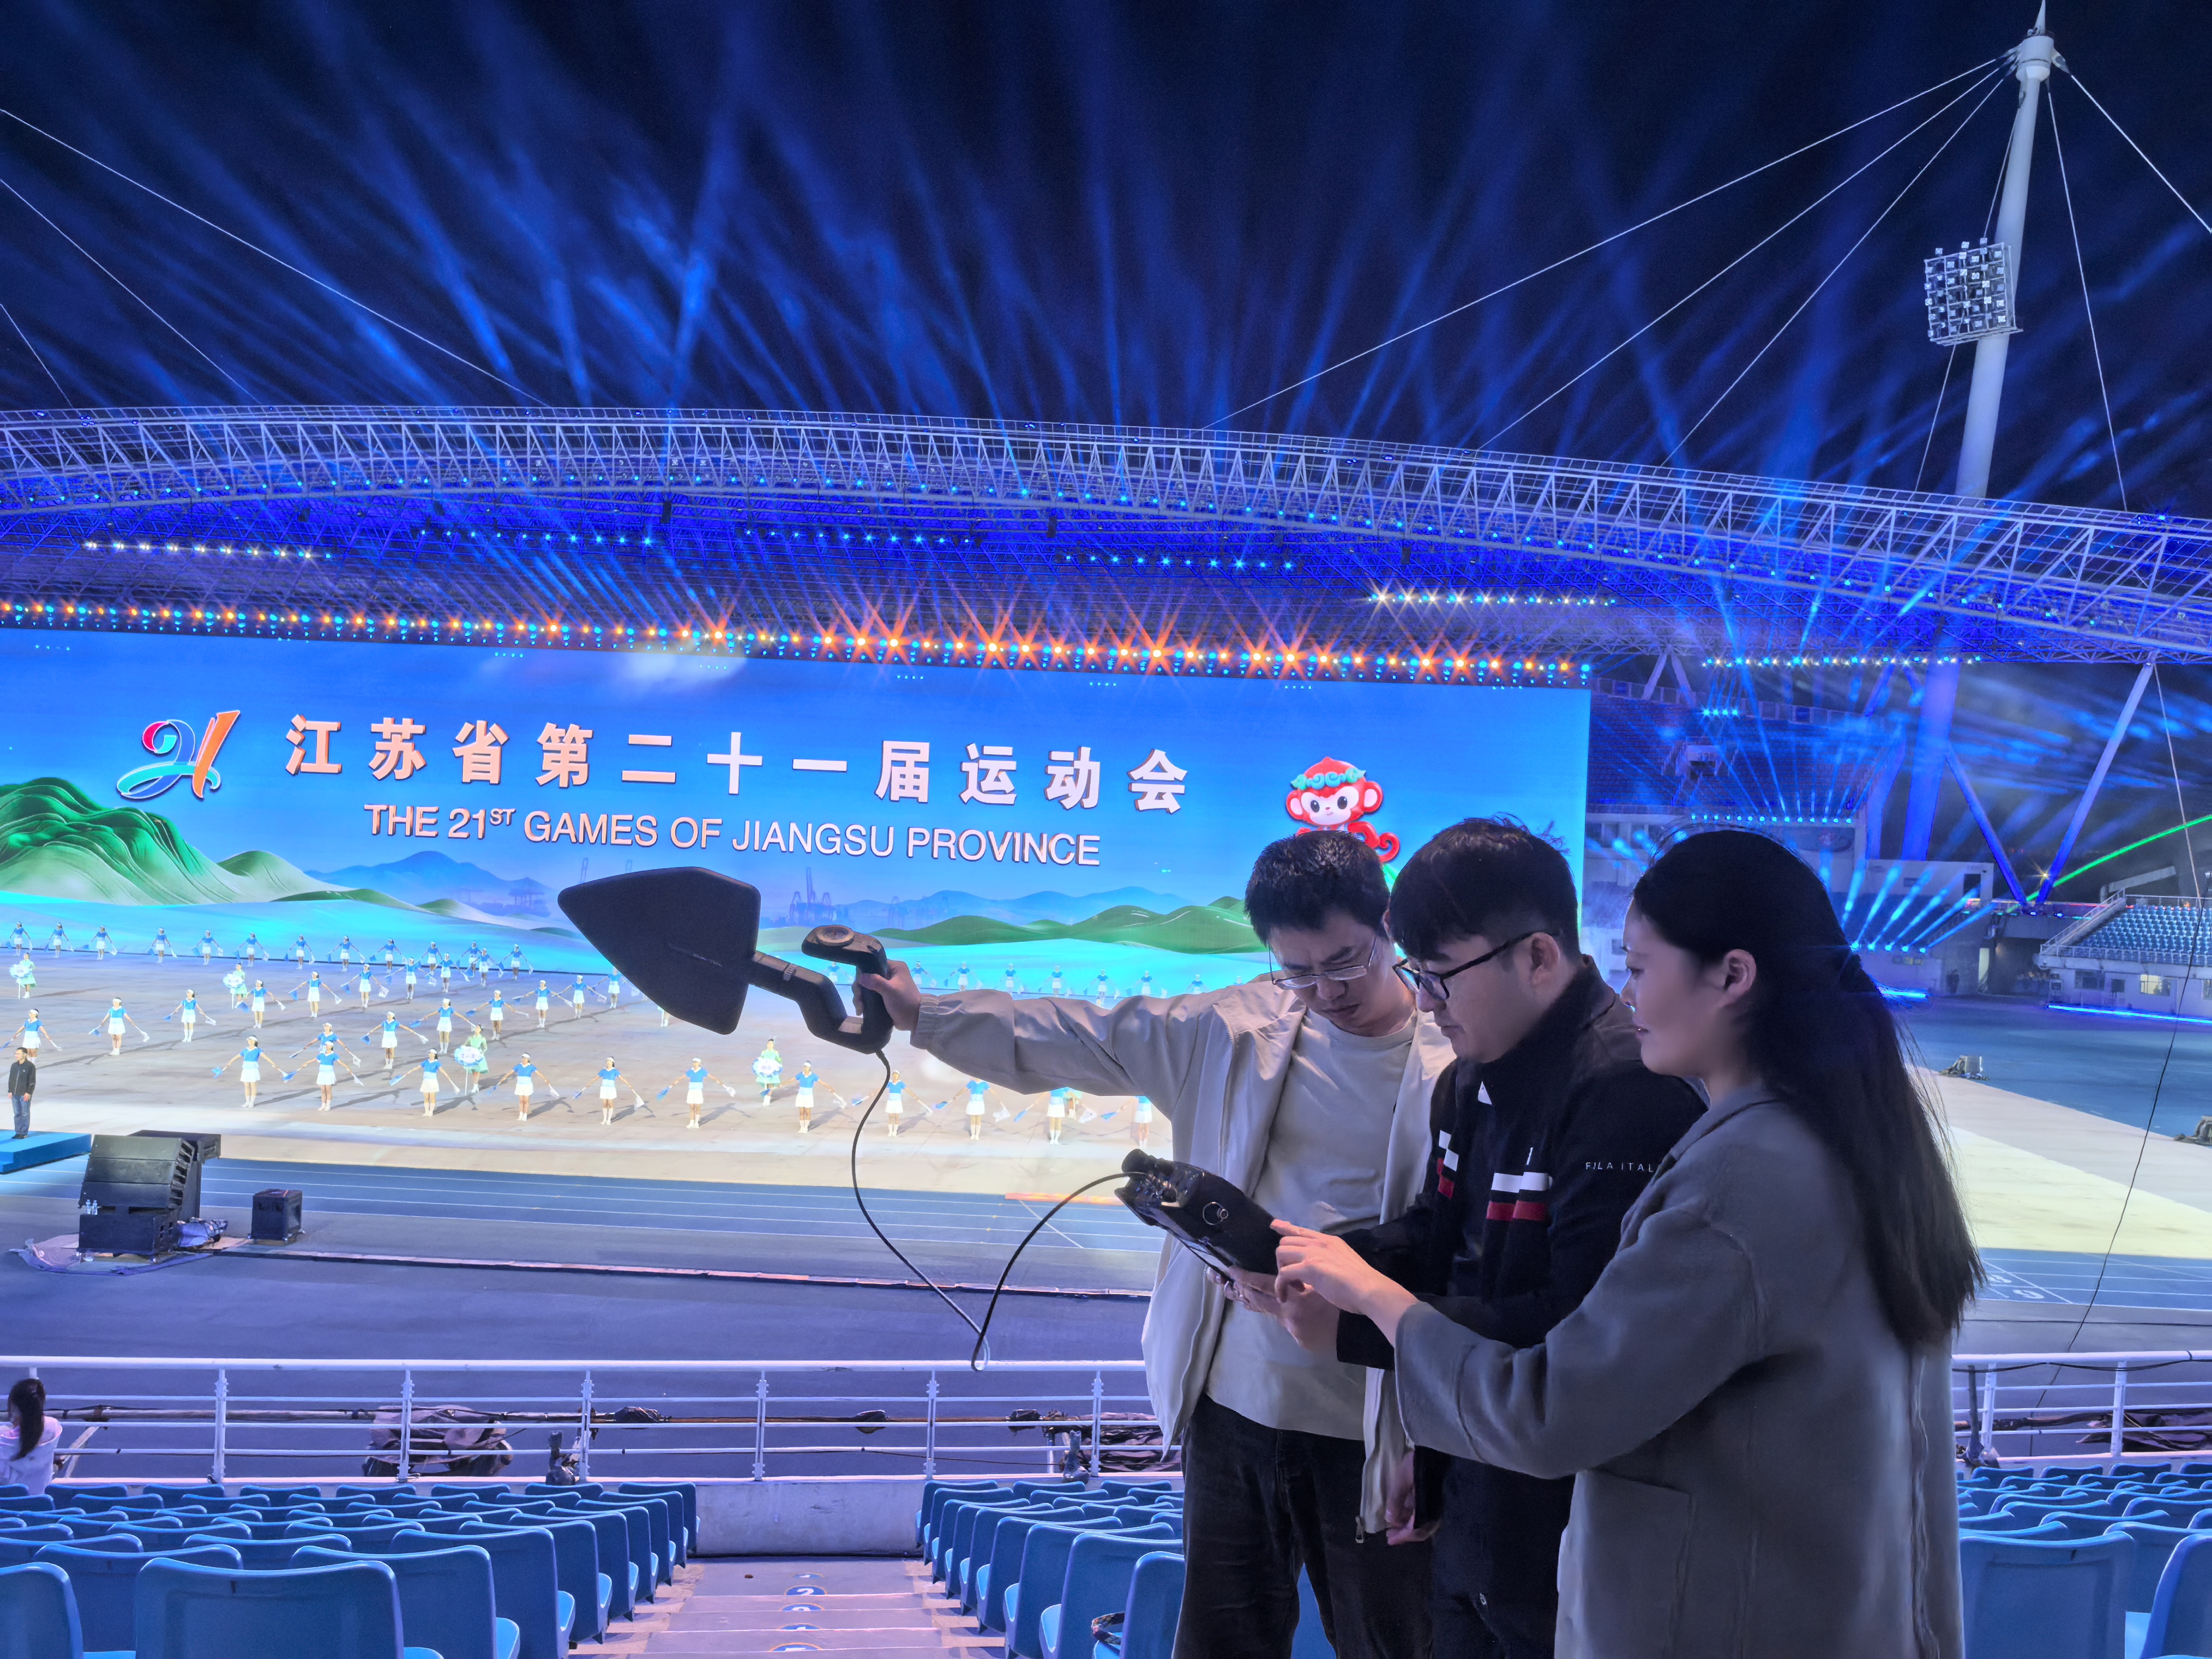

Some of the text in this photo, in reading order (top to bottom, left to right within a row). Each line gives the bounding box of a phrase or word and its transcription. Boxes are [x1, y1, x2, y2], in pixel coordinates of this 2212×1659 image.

[286, 714, 1188, 813] 江苏省第二十一届运动会
[364, 804, 1100, 866] THE 21ST GAMES OF JIANGSU PROVINCE
[1586, 1162, 1613, 1170] FILA
